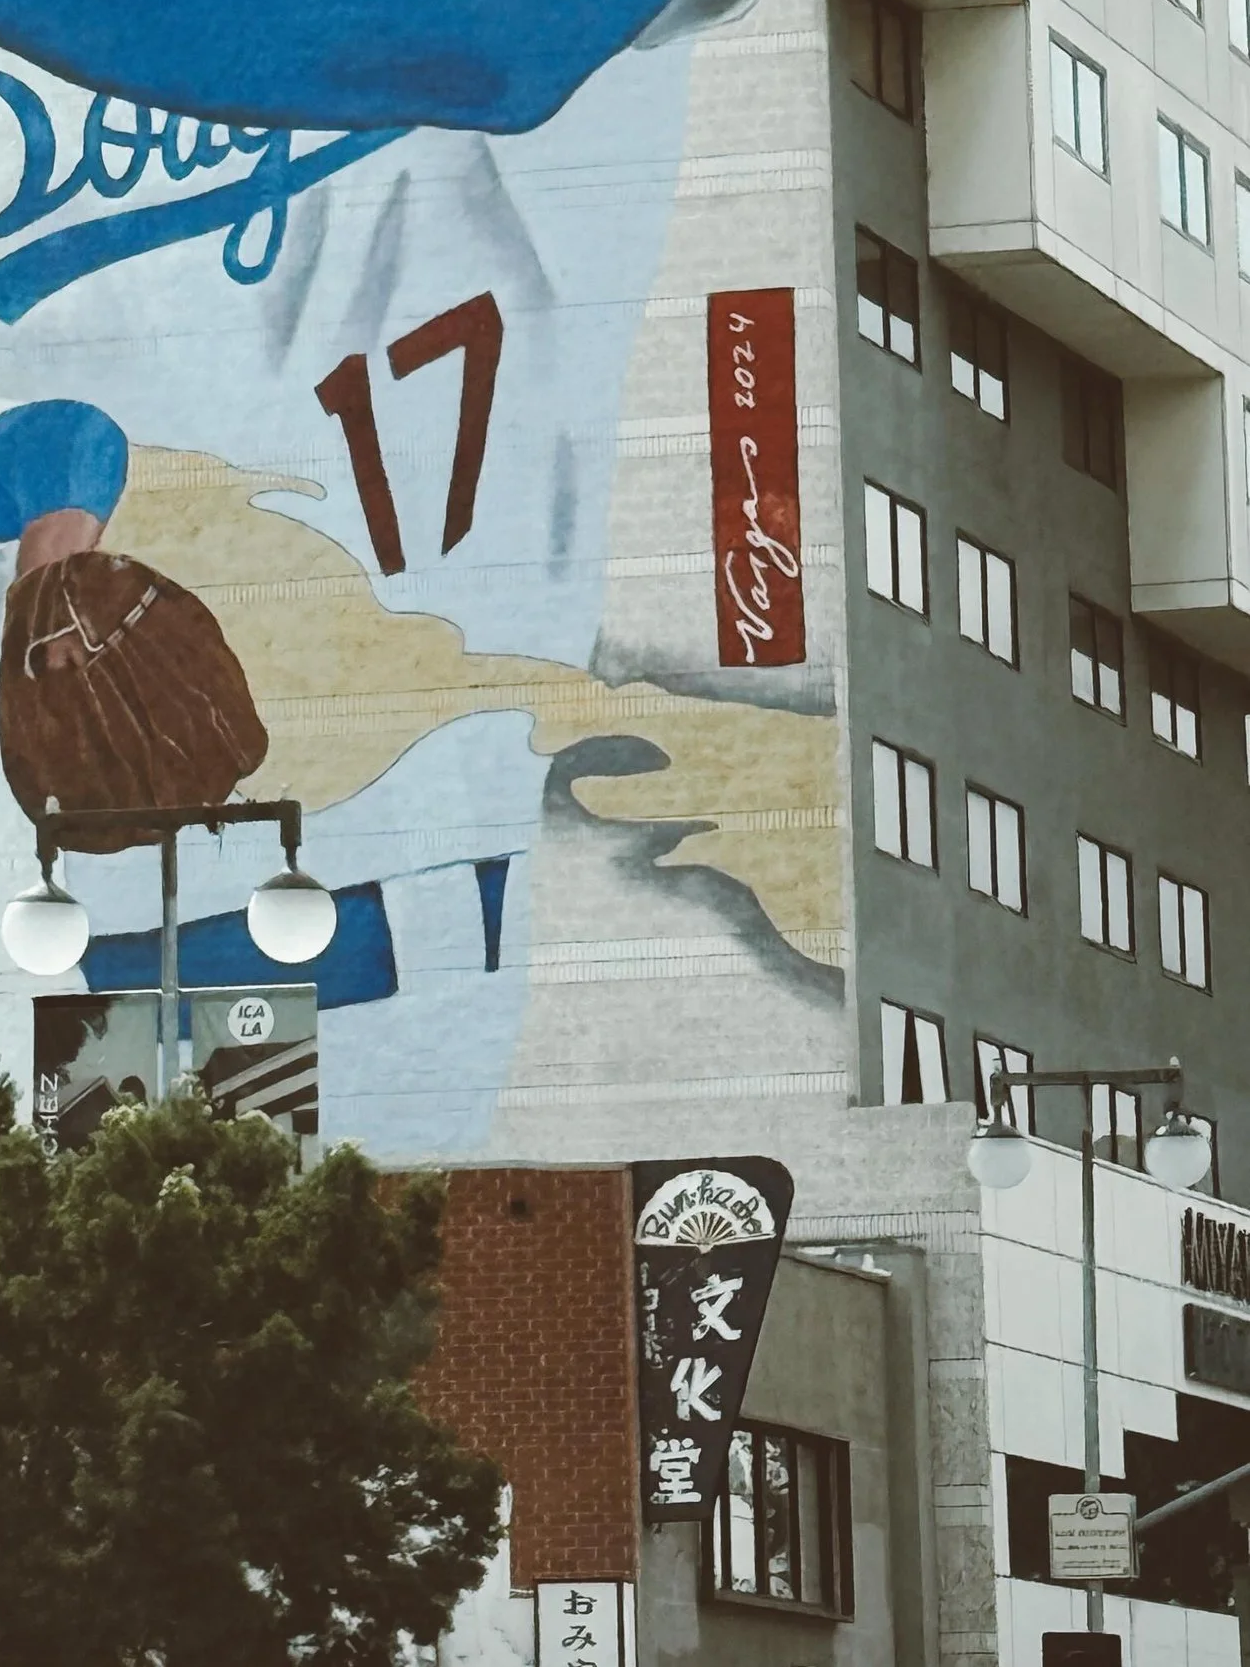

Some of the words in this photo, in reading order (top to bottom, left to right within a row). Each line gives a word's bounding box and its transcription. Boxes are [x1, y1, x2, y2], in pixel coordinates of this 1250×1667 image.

[729, 312, 756, 410] 2024
[314, 290, 504, 577] 17
[237, 1004, 265, 1020] ICA
[240, 1022, 263, 1038] LA
[648, 1274, 744, 1504] 文化堂
